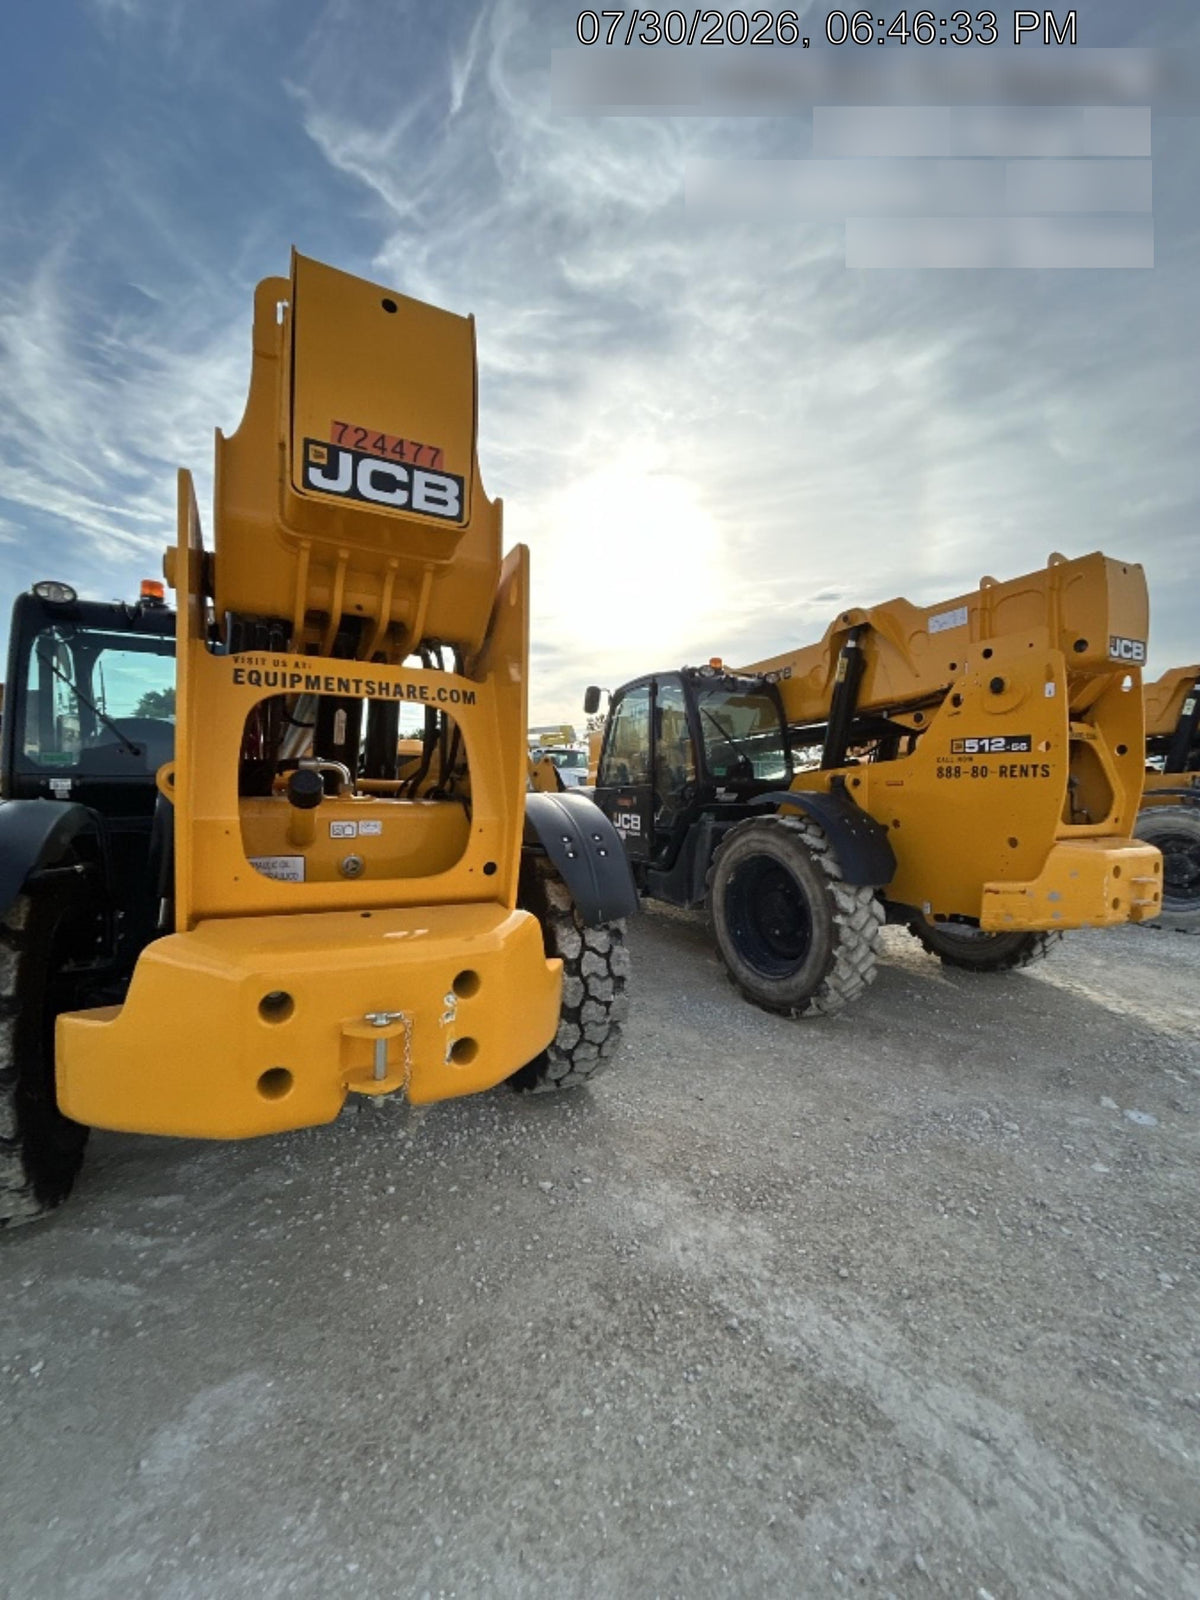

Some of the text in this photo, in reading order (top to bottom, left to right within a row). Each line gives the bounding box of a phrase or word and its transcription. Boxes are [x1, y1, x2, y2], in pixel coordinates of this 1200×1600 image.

[333, 421, 441, 468] 724477
[308, 451, 460, 517] JCB
[233, 656, 266, 666] VISIT
[273, 659, 288, 668] US
[1110, 638, 1145, 660] JCB
[233, 668, 476, 705] EQUIPMENTSHARE.COM
[613, 812, 641, 830] JCB
